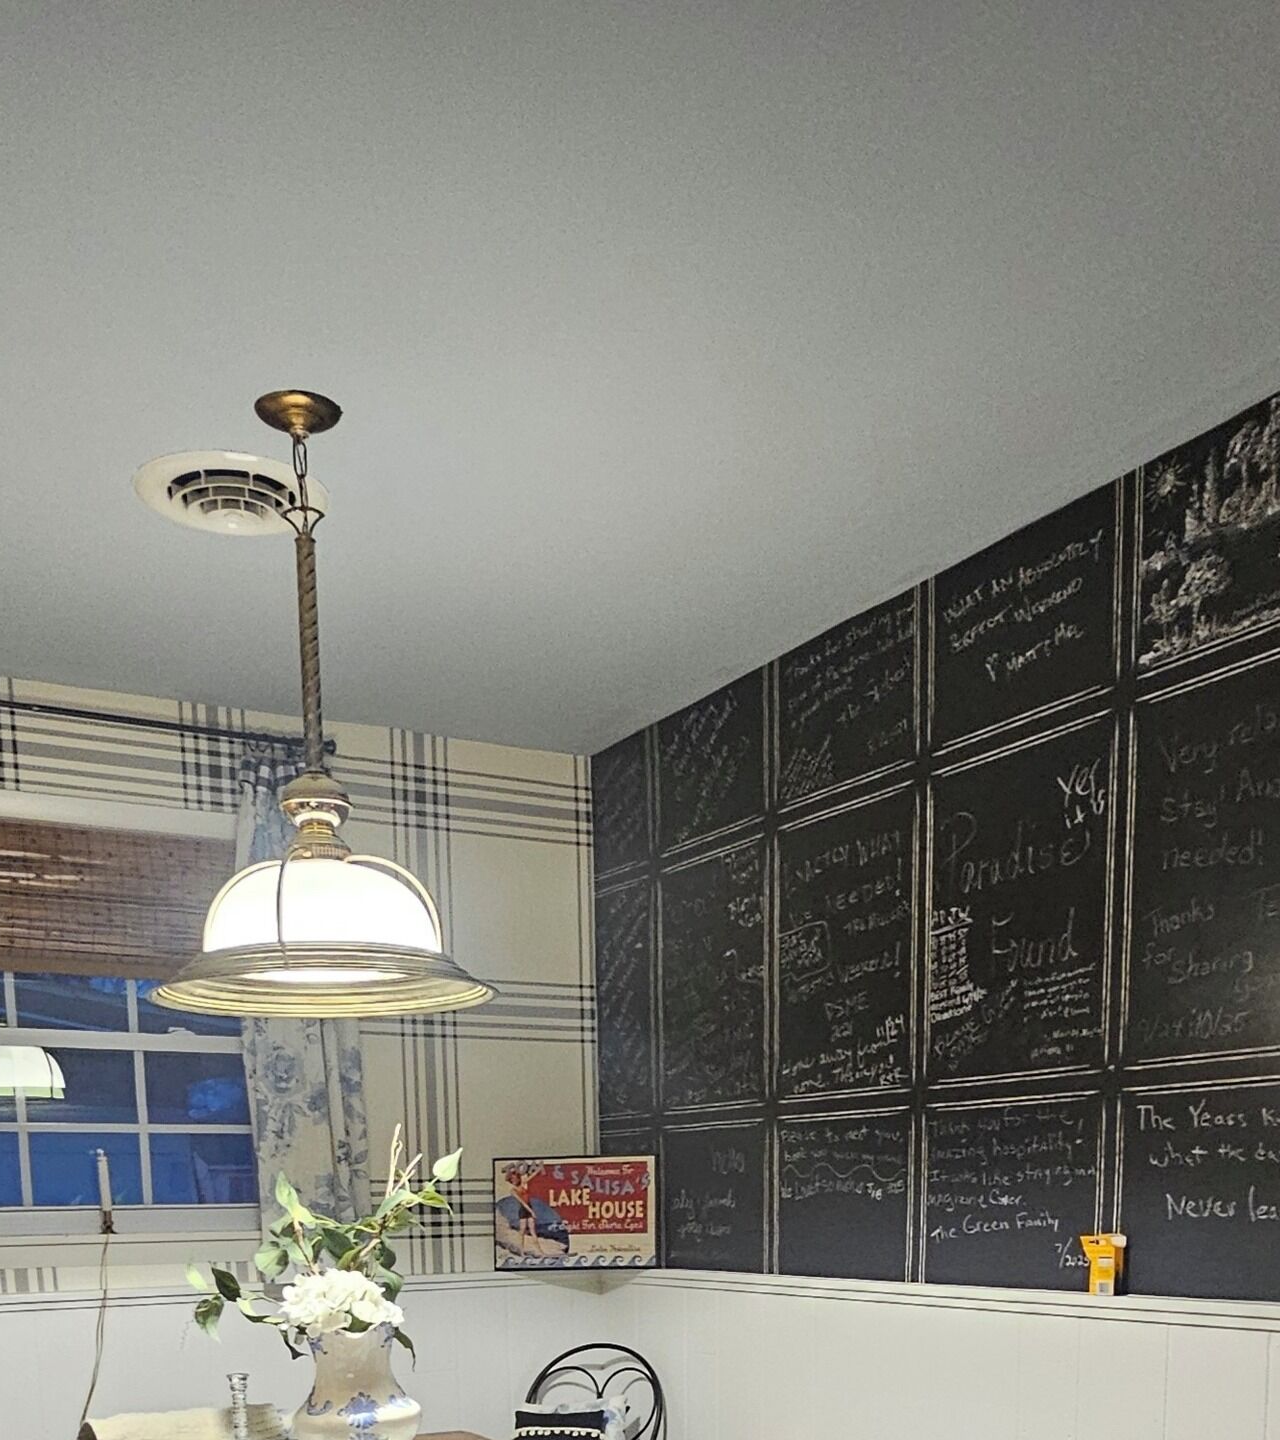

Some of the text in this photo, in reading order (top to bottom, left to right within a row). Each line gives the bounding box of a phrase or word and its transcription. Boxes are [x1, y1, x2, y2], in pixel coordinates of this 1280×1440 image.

[1136, 1104, 1176, 1131] The
[1188, 1098, 1249, 1128] Years
[1149, 1141, 1209, 1168] what
[1218, 1143, 1247, 1162] the
[549, 1187, 591, 1207] LAKE
[588, 1200, 644, 1219] HOUSE
[1166, 1192, 1237, 1221] Never
[930, 1210, 1060, 1245] The Green Family
